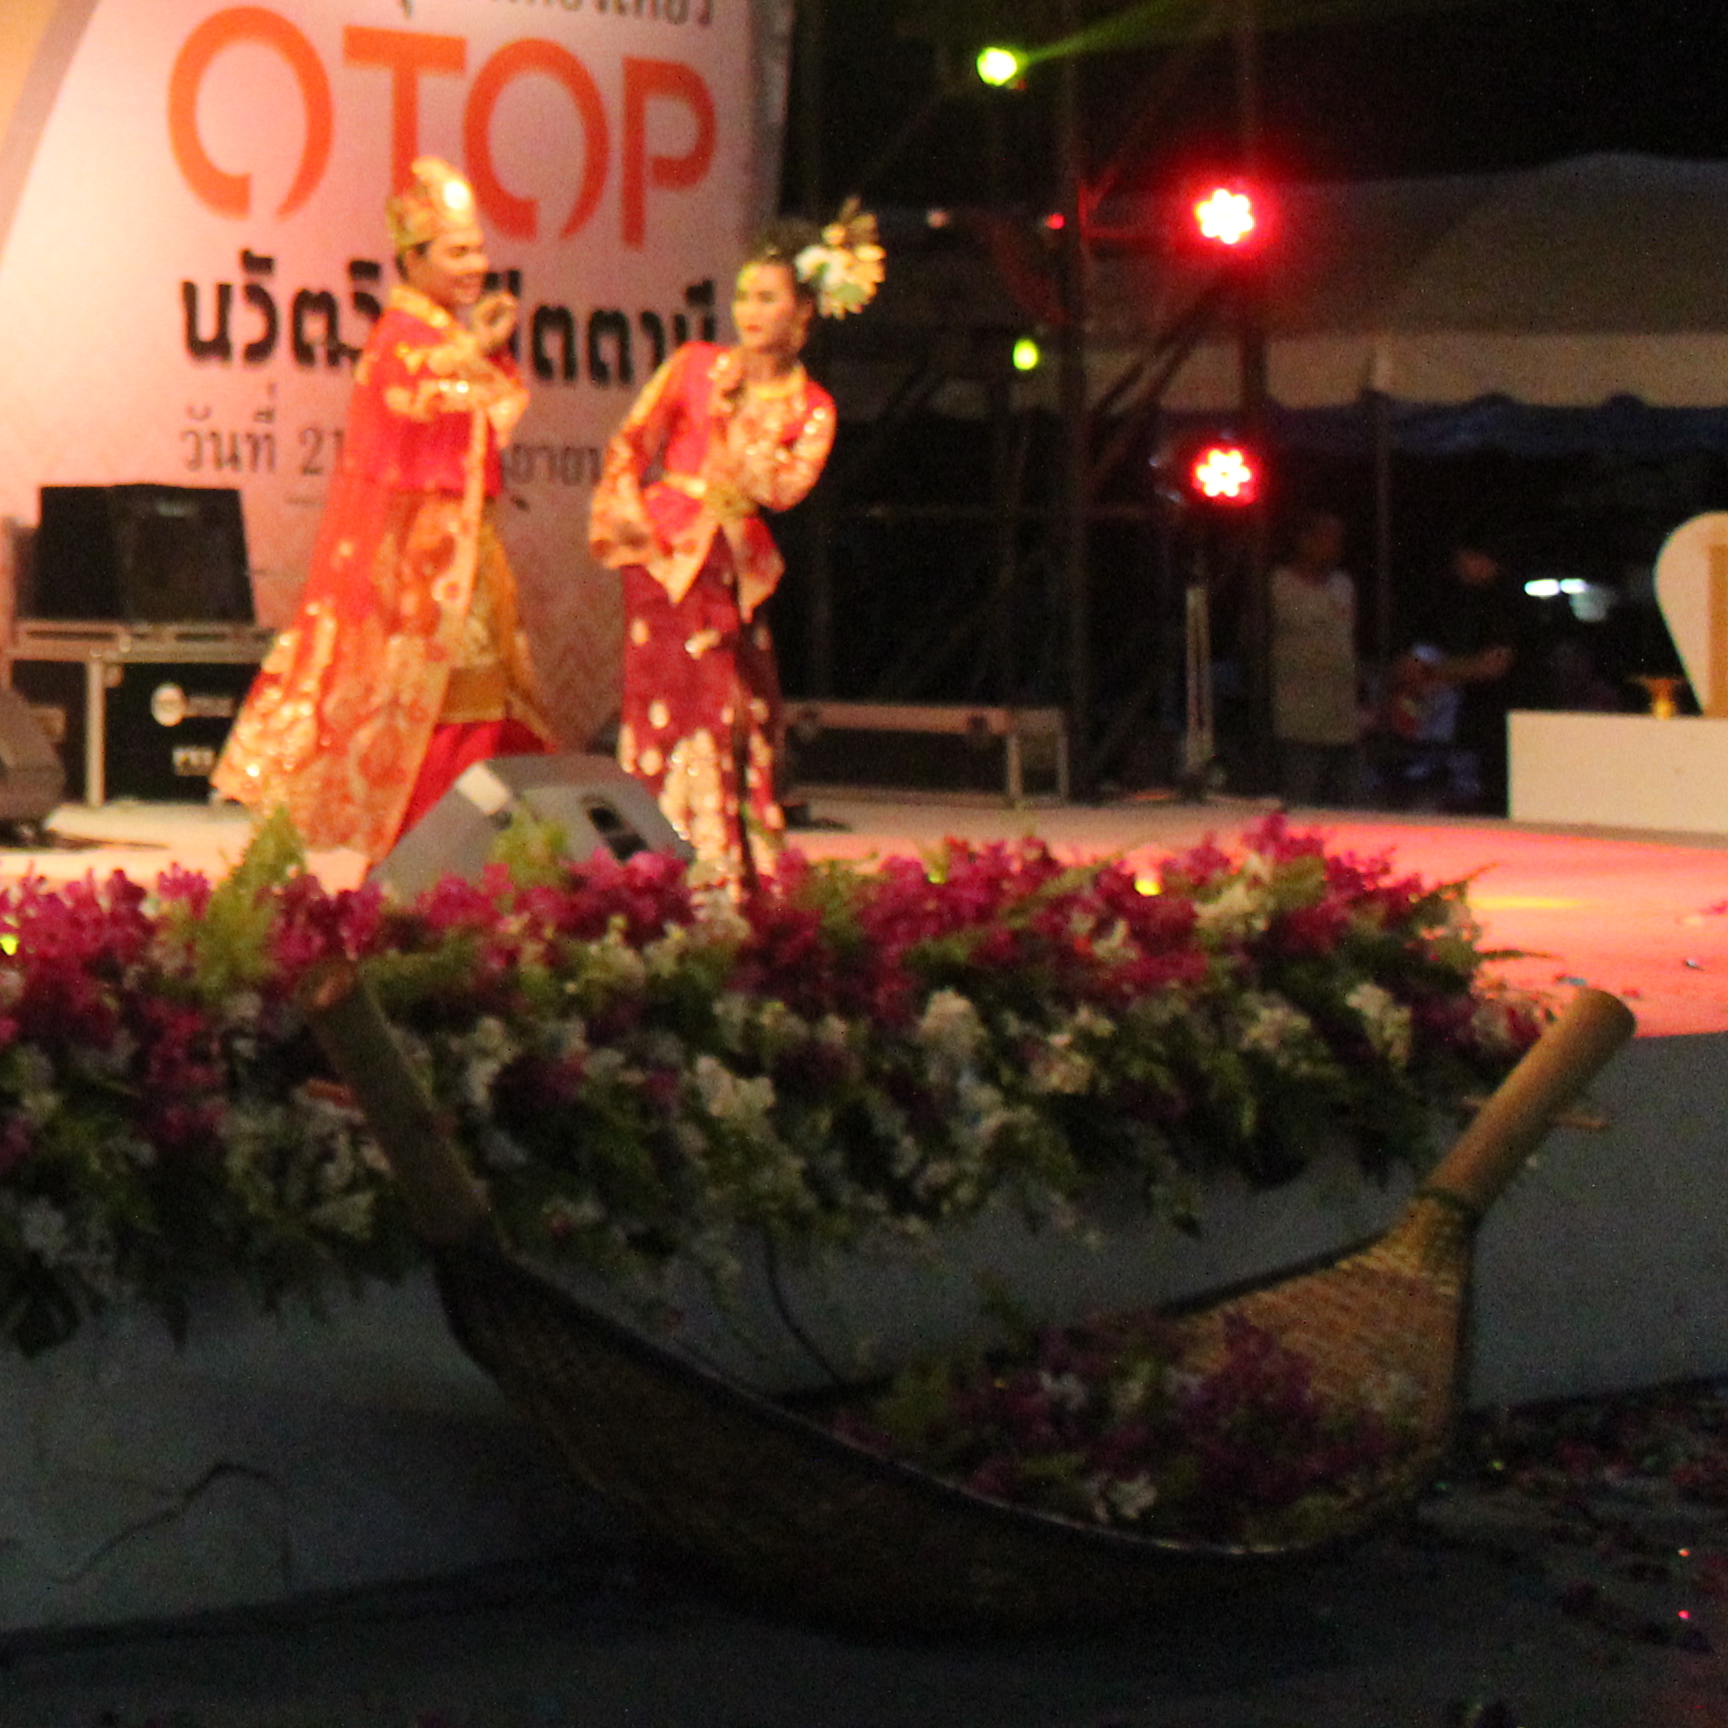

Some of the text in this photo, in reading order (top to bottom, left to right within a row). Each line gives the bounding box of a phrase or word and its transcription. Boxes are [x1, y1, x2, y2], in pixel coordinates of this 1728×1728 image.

[166, 5, 718, 249] OTOP
[180, 381, 277, 474] วันที่
